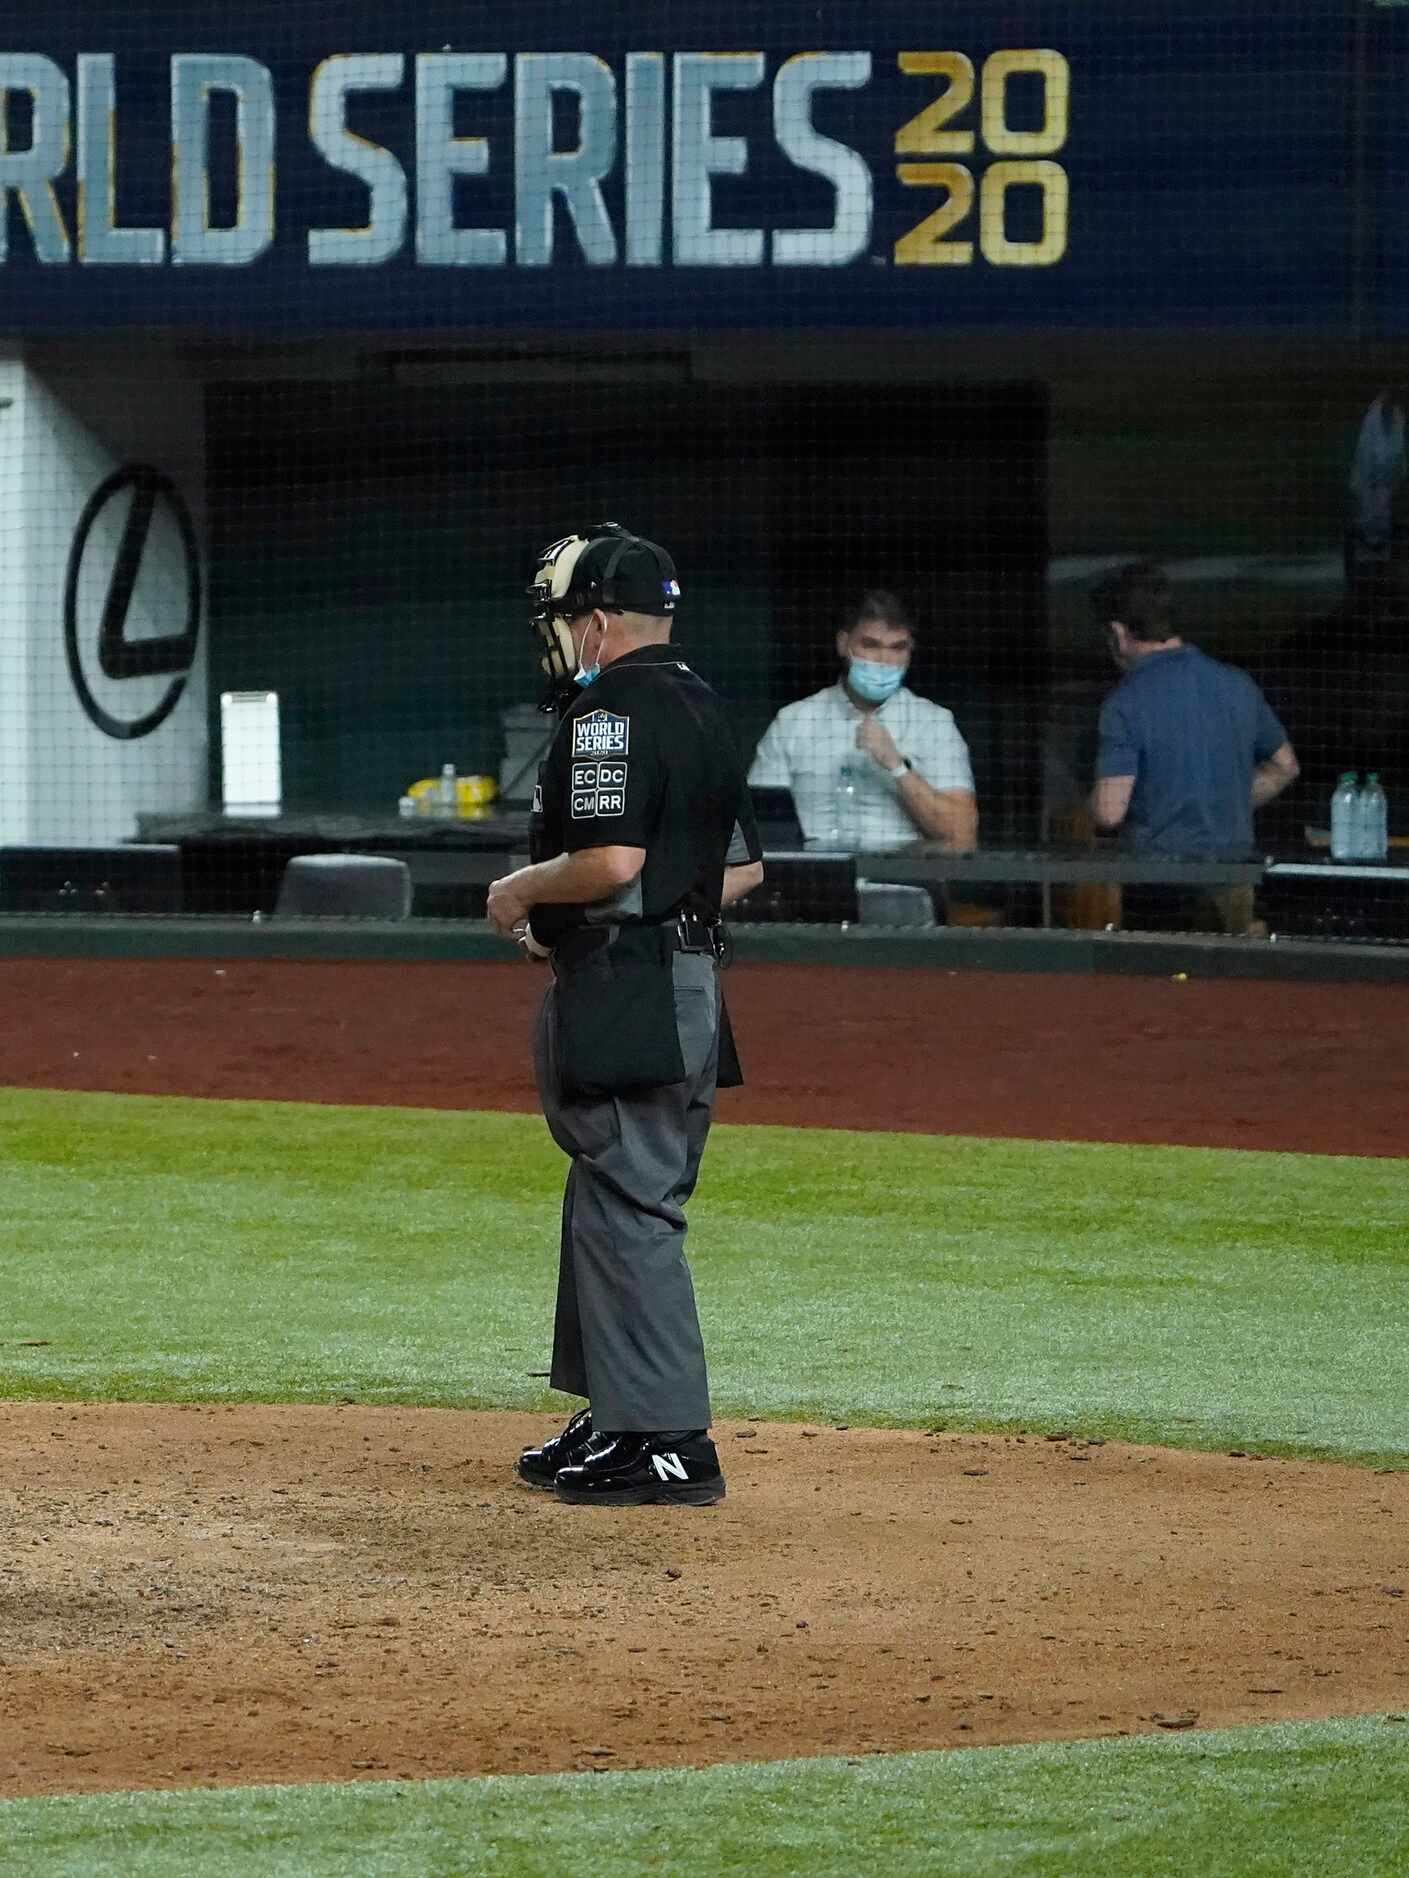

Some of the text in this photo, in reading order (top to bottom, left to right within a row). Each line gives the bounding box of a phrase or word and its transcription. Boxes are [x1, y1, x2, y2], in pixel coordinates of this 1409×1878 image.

[894, 48, 1068, 155] 20
[308, 51, 873, 268] SERIES
[894, 160, 1068, 268] 20
[577, 722, 624, 736] WORLD
[576, 736, 624, 751] SERIES
[575, 769, 624, 785] EC DC
[574, 795, 621, 811] CM RR
